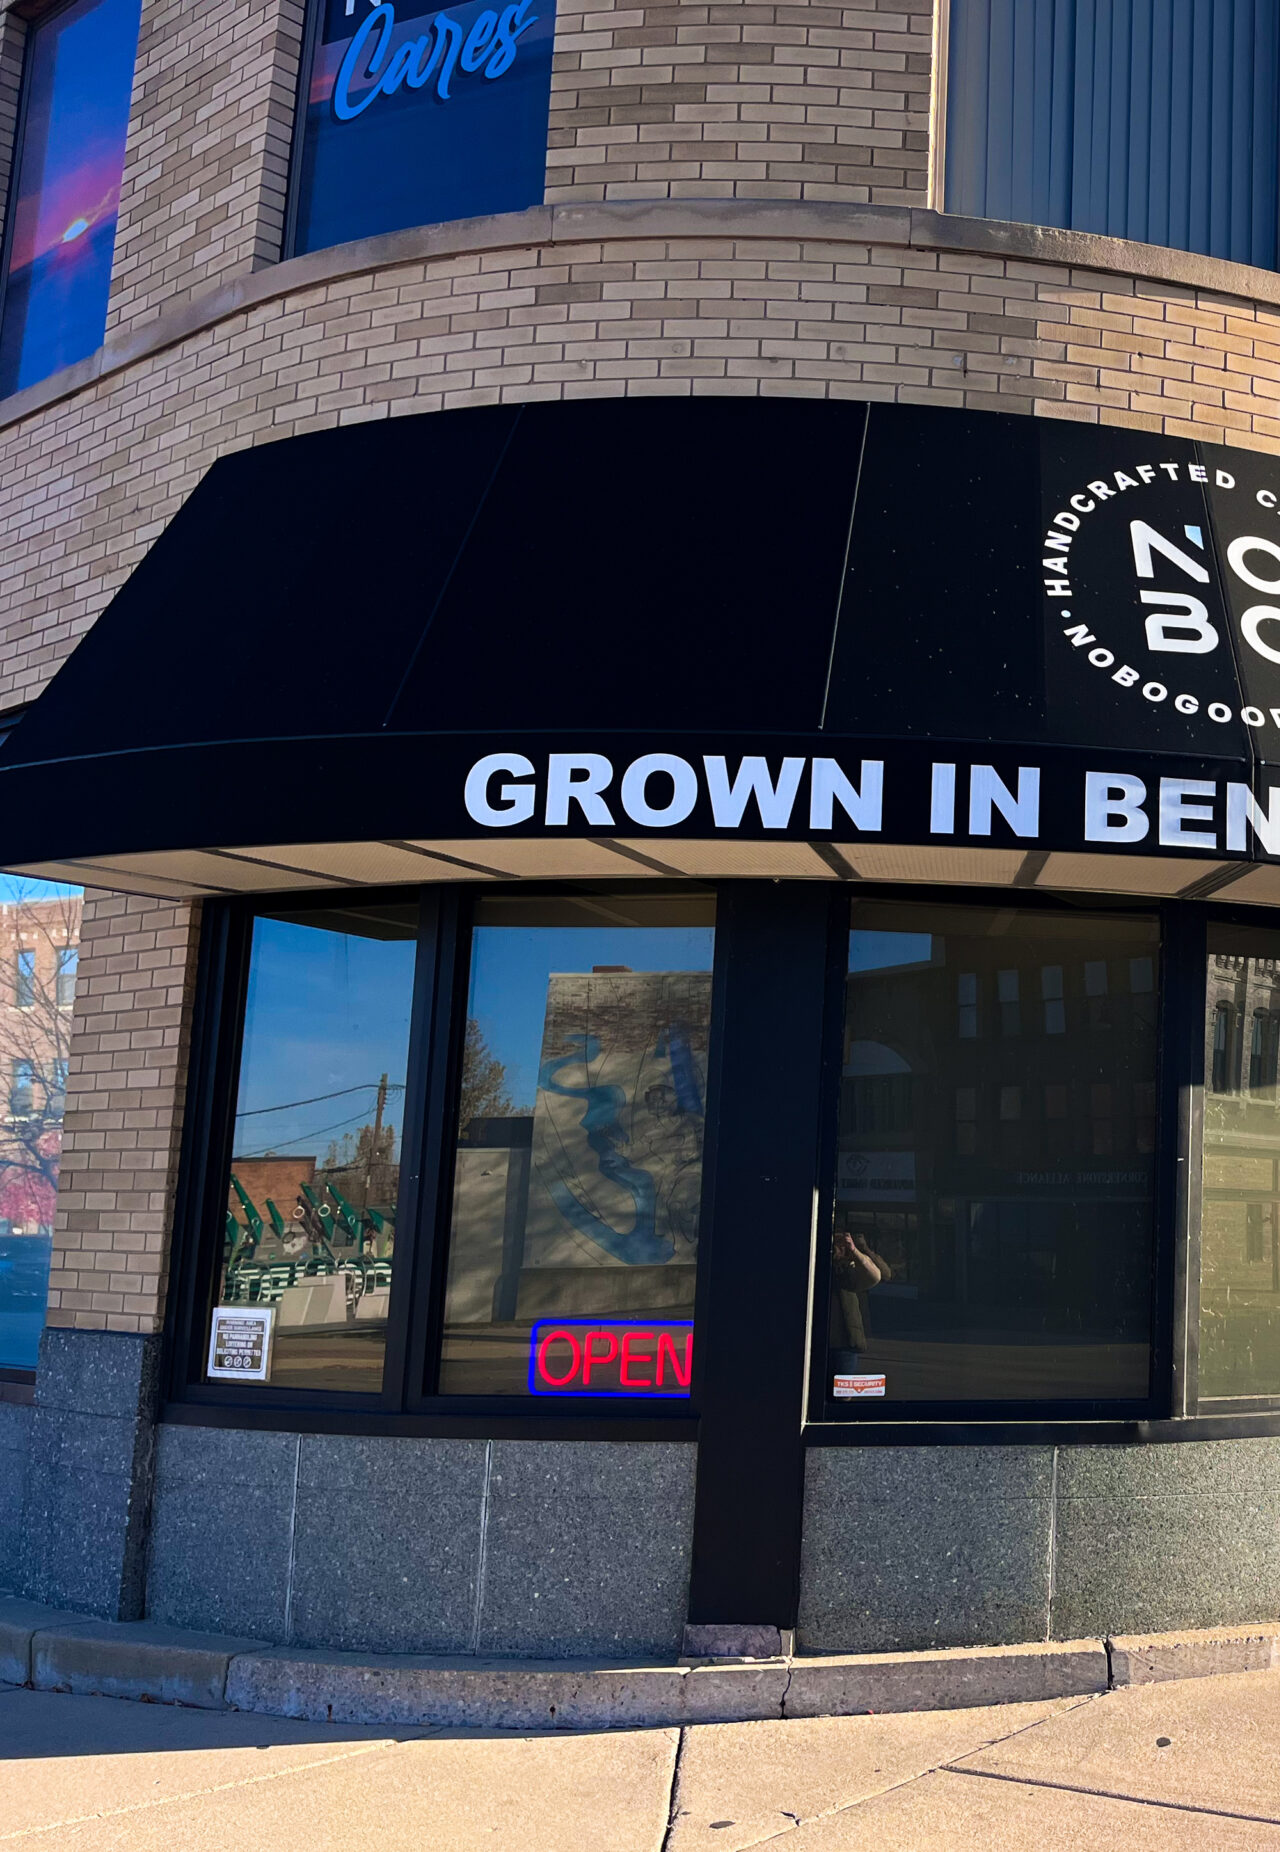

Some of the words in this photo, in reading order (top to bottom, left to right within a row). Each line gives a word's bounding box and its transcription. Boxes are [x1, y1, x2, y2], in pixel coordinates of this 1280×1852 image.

[334, 0, 540, 121] Cares
[1042, 462, 1236, 597] HANDCRAFTED
[463, 752, 885, 832] GROWN
[929, 761, 1041, 838] IN
[537, 1330, 693, 1387] OPEN
